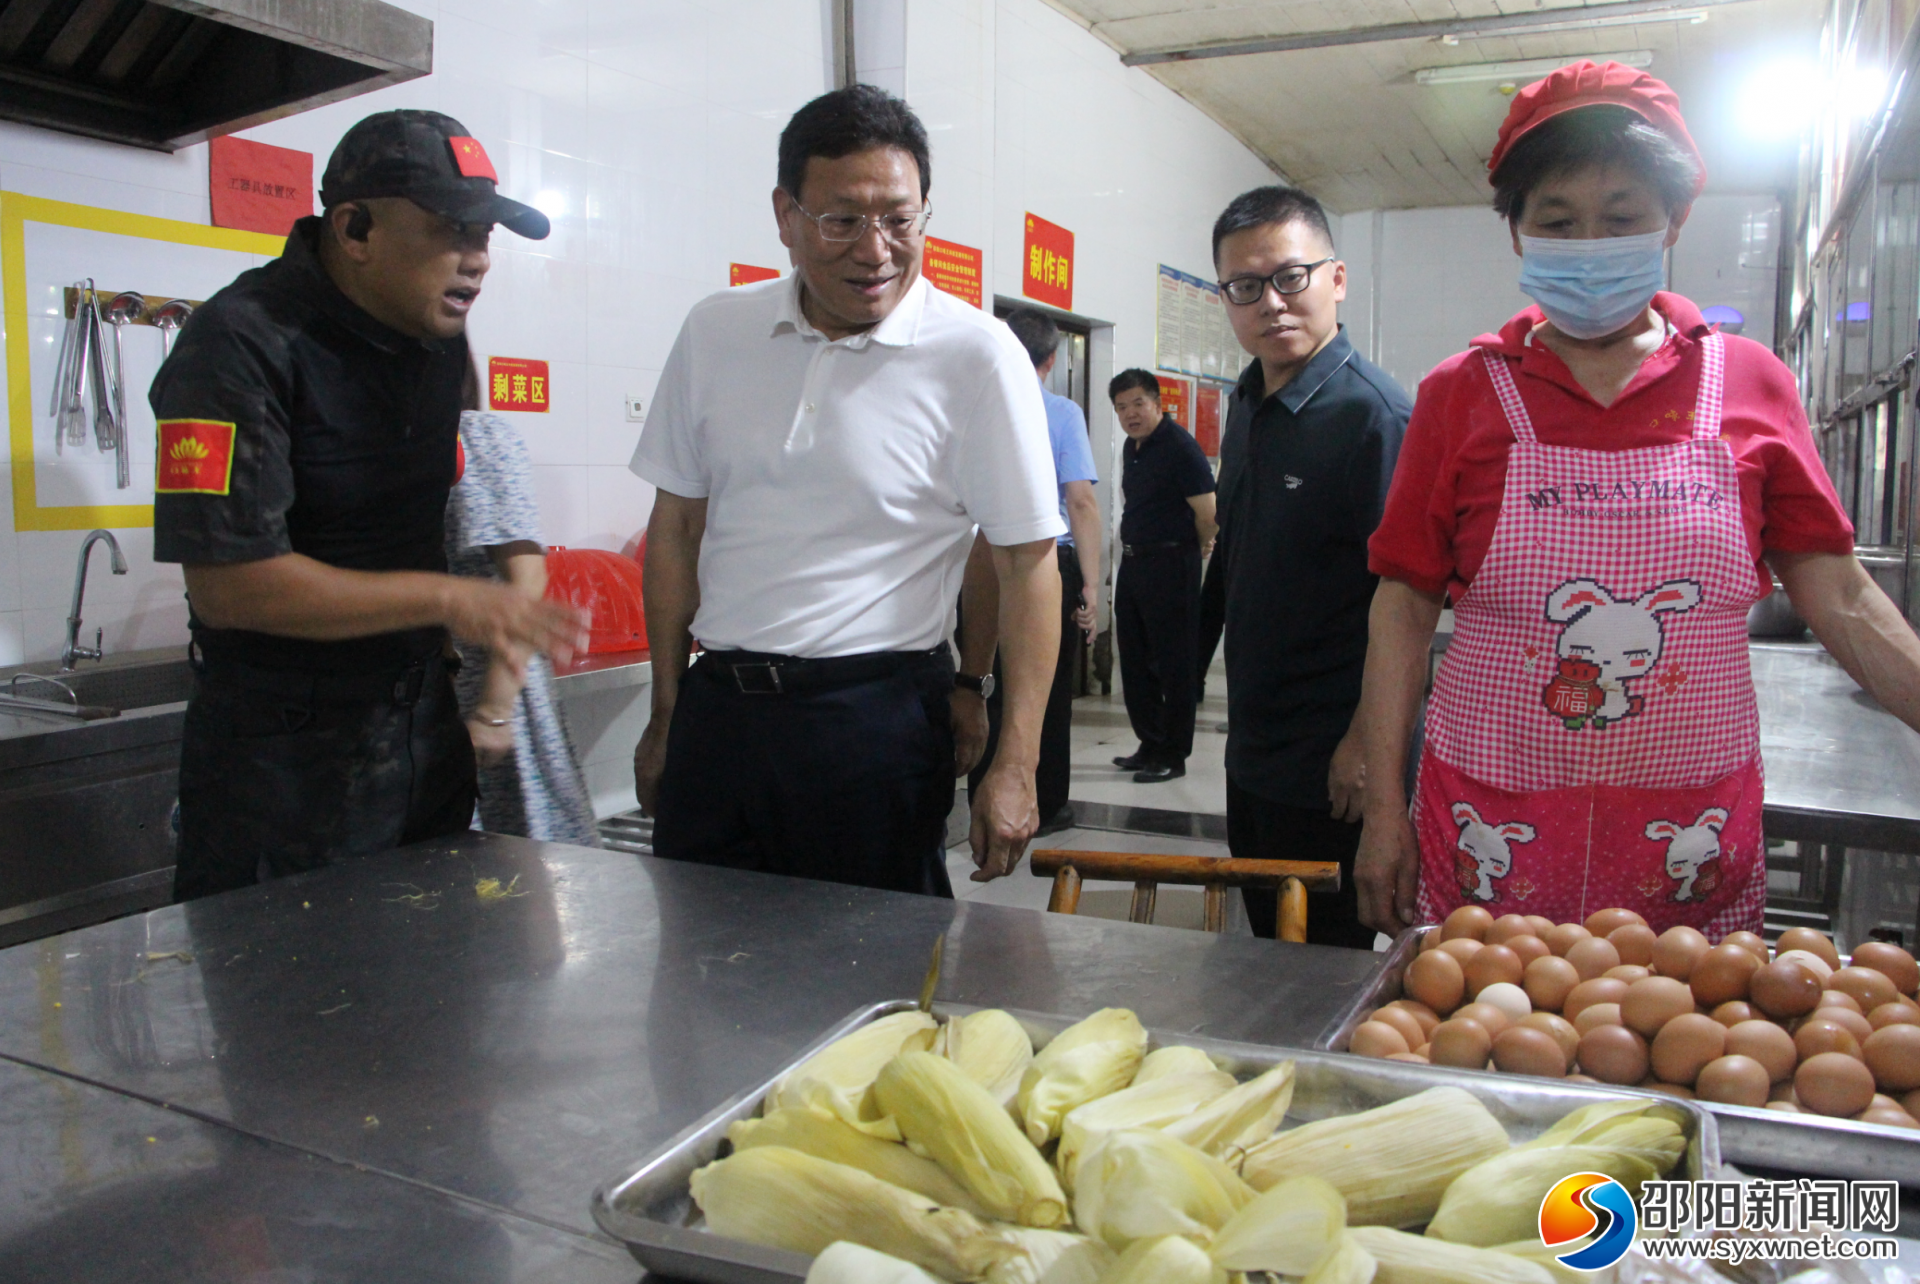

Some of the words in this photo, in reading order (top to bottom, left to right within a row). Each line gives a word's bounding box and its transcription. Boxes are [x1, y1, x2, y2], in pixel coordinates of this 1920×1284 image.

[228, 178, 297, 200] 工器具放置区
[1030, 244, 1068, 290] 制作间
[493, 373, 545, 403] 剩菜区
[1525, 486, 1563, 511] MY
[1573, 480, 1724, 511] PLAYMATE
[1553, 685, 1589, 713] 福
